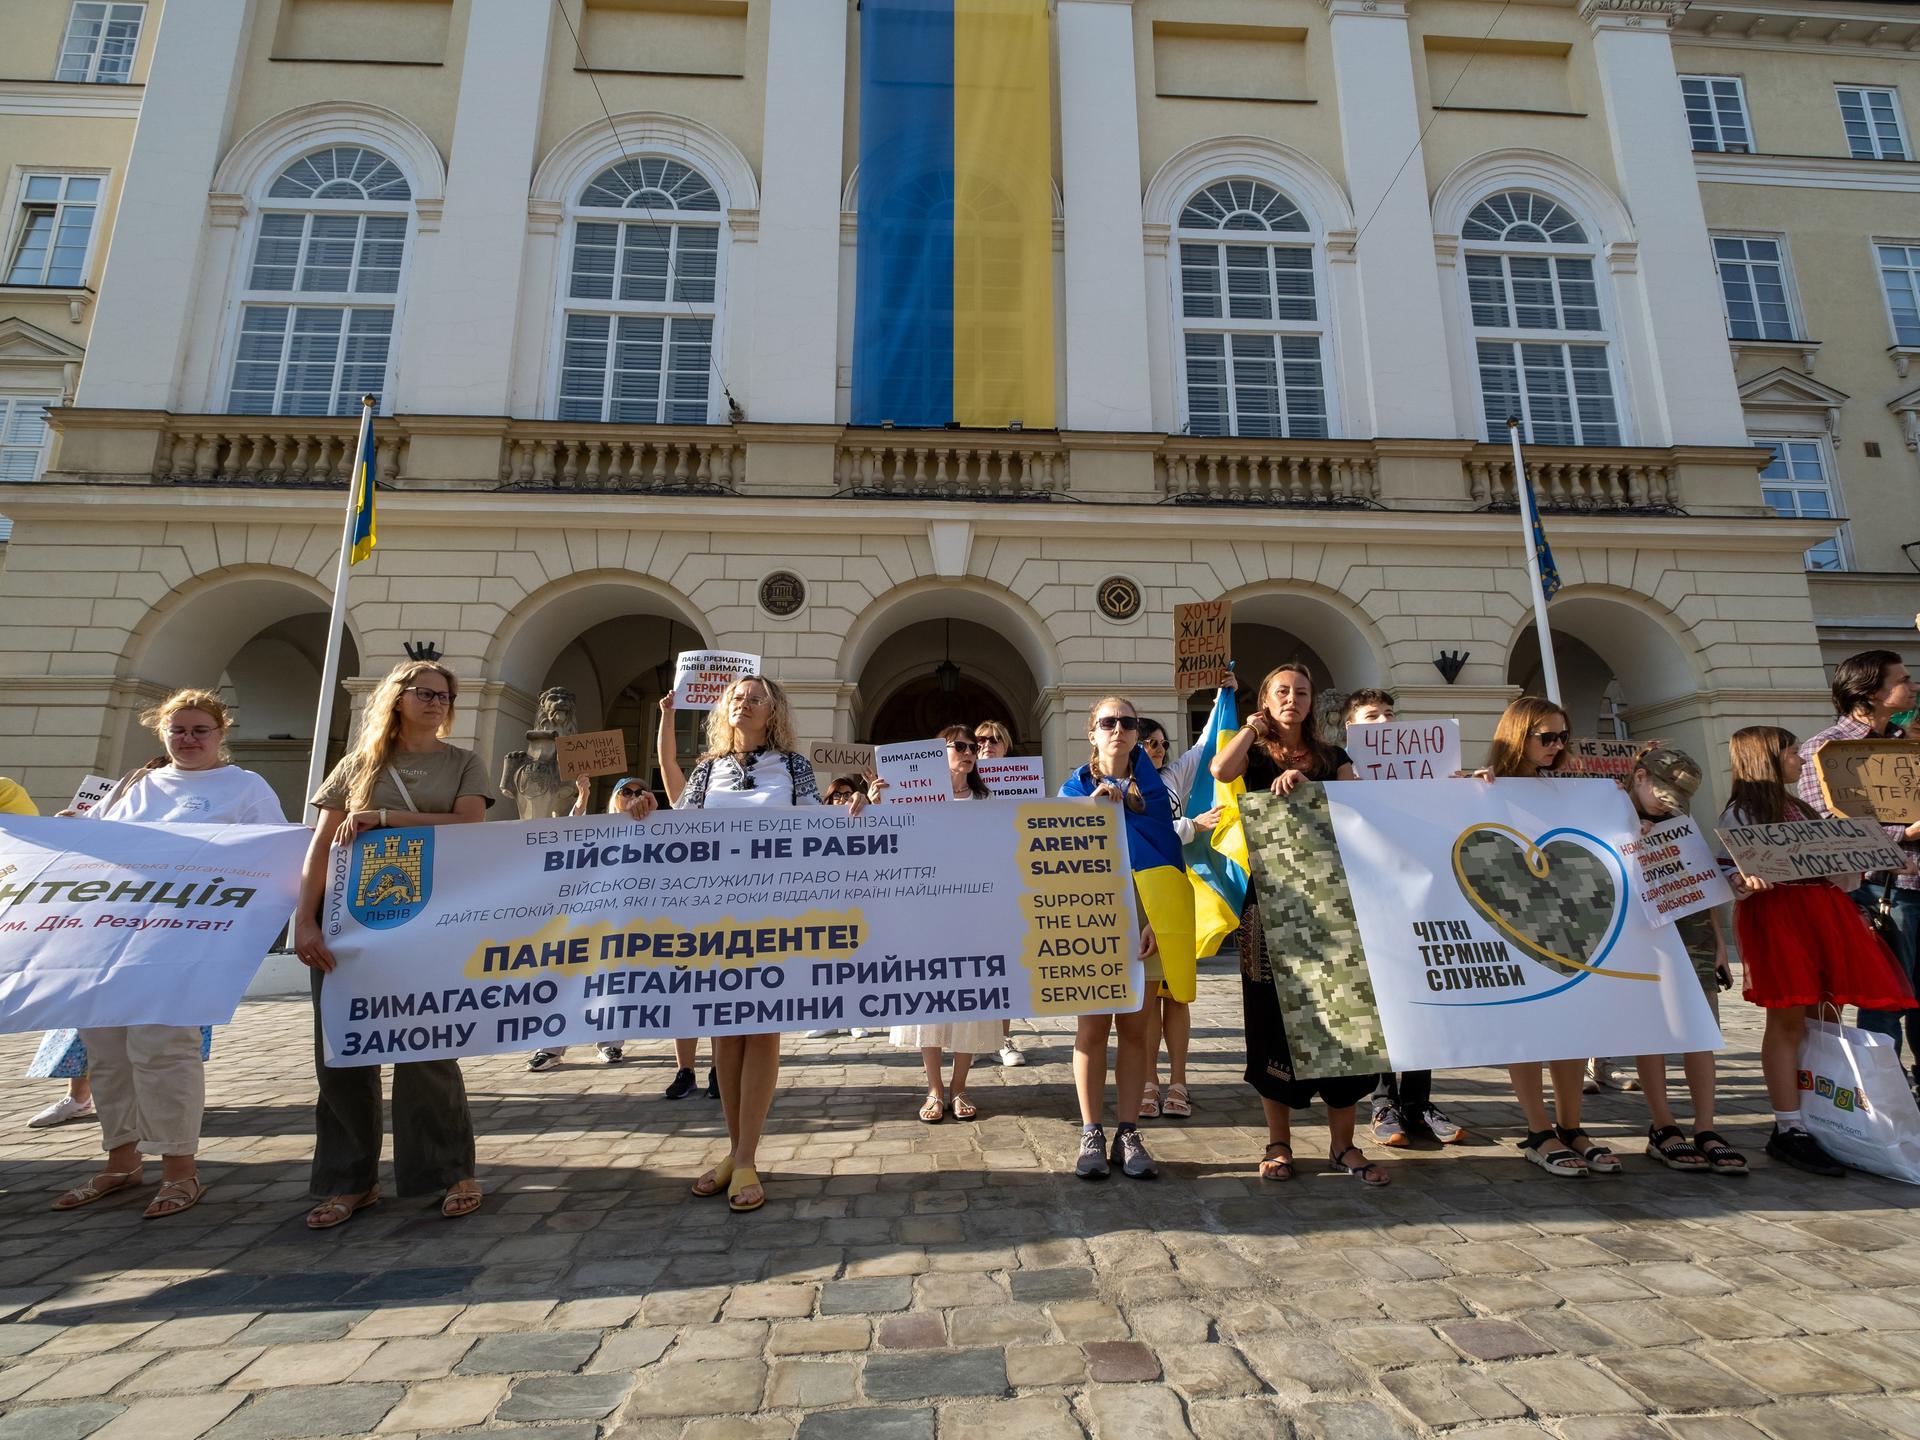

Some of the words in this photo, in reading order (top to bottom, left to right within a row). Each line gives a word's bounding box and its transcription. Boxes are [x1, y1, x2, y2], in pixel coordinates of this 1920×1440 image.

[1184, 602, 1222, 620] ХОЧУ
[1181, 616, 1226, 637] ЖИТИ
[1178, 634, 1225, 655] СЕРЕД
[710, 664, 754, 674] ВИМАГАЄ
[1177, 653, 1226, 673] ЖИВИХ
[699, 672, 732, 682] ЧІТКІ
[565, 738, 613, 751] ЗАМІНИ
[1365, 726, 1444, 755] ЧЕКАЮ
[595, 746, 621, 757] МЕНЕ
[813, 748, 871, 766] СКІЛЬКИ
[881, 750, 943, 764] ВИМАГАЄМО
[568, 761, 575, 773] Я
[578, 760, 591, 770] НА
[593, 756, 621, 769] МЕЖІ
[977, 764, 1029, 774] ВИЗНАЧЕНІ
[1367, 759, 1434, 780] ТАТА
[900, 778, 932, 789] ЧІТКІ
[79, 791, 104, 801] спо
[526, 831, 559, 845] БЕЗ
[563, 824, 645, 842] ТЕРМІНІВ
[650, 820, 725, 836] СЛУЖБИ
[731, 819, 753, 833] НЕ
[759, 817, 802, 834] БУДЕ
[807, 812, 915, 830] МОБІЛІЗАЦІЇ!
[1027, 816, 1105, 829] SERVICES
[1029, 835, 1108, 852] AREN’T
[1643, 824, 1694, 847] ЧІТКИХ
[544, 841, 720, 872] ВІЙСЬКОВІ
[751, 837, 792, 859] НЕ
[802, 834, 898, 858] РАБИ!
[1789, 851, 1847, 877] МОЖЕ
[1844, 847, 1905, 872] КОЖЕН
[174, 864, 272, 878] організація
[1031, 859, 1111, 875] SLAVES!
[1642, 860, 1685, 883] СЛУЖБИ
[558, 878, 656, 897] ВІЙСЬКОВІ
[660, 872, 773, 891] ЗАСЛУЖИЛИ
[778, 869, 840, 886] ПРАВО
[846, 868, 869, 882] НА
[874, 866, 936, 881] ЖИТТЯ!
[1646, 869, 1717, 902] ДЕМОТИВОВАНІ
[436, 907, 489, 927] ДАЙТЕ
[493, 902, 554, 920] СПОКІЙ
[556, 898, 618, 916] ЛЮДЯМ,
[623, 896, 647, 908] ЯКІ
[661, 895, 689, 908] ТАК
[691, 894, 712, 907] ЗА
[713, 893, 722, 906] 2
[727, 890, 769, 905] РОКИ
[773, 888, 840, 904] ВІДДАЛИ
[844, 885, 891, 900] КРАЇНІ
[895, 882, 993, 898] НАЙЦІННІШЕ!
[1033, 892, 1115, 908] SUPPORT
[34, 915, 84, 932] Дія.
[94, 914, 233, 932] Результат!
[364, 908, 411, 921] ЛЬВІВ
[1035, 915, 1071, 929] THE
[1077, 913, 1117, 928] LAW
[1412, 920, 1473, 942] ЧІТКІ
[483, 937, 589, 972] ПАНЕ
[600, 924, 859, 960] ПРЕЗИДЕНТЕ!
[1037, 936, 1120, 957] ABOUT
[1418, 941, 1510, 967] ТЕРМІНИ
[1039, 964, 1096, 979] TERMS
[1101, 963, 1123, 977] OF
[1426, 964, 1526, 991] СЛУЖБИ
[349, 980, 558, 1021] ВИМАГАЄМО
[583, 964, 785, 998] НЕГАЙНОГО
[812, 954, 1006, 986] ПРИЙНЯТТЯ
[1041, 984, 1127, 1002] SERVICE!
[341, 1021, 476, 1056] ЗАКОНУ
[497, 1013, 566, 1042] ПРО
[585, 1005, 671, 1031] ЧІТКІ
[692, 995, 843, 1026] ТЕРМІНИ
[859, 987, 1010, 1018] СЛУЖБИ!
